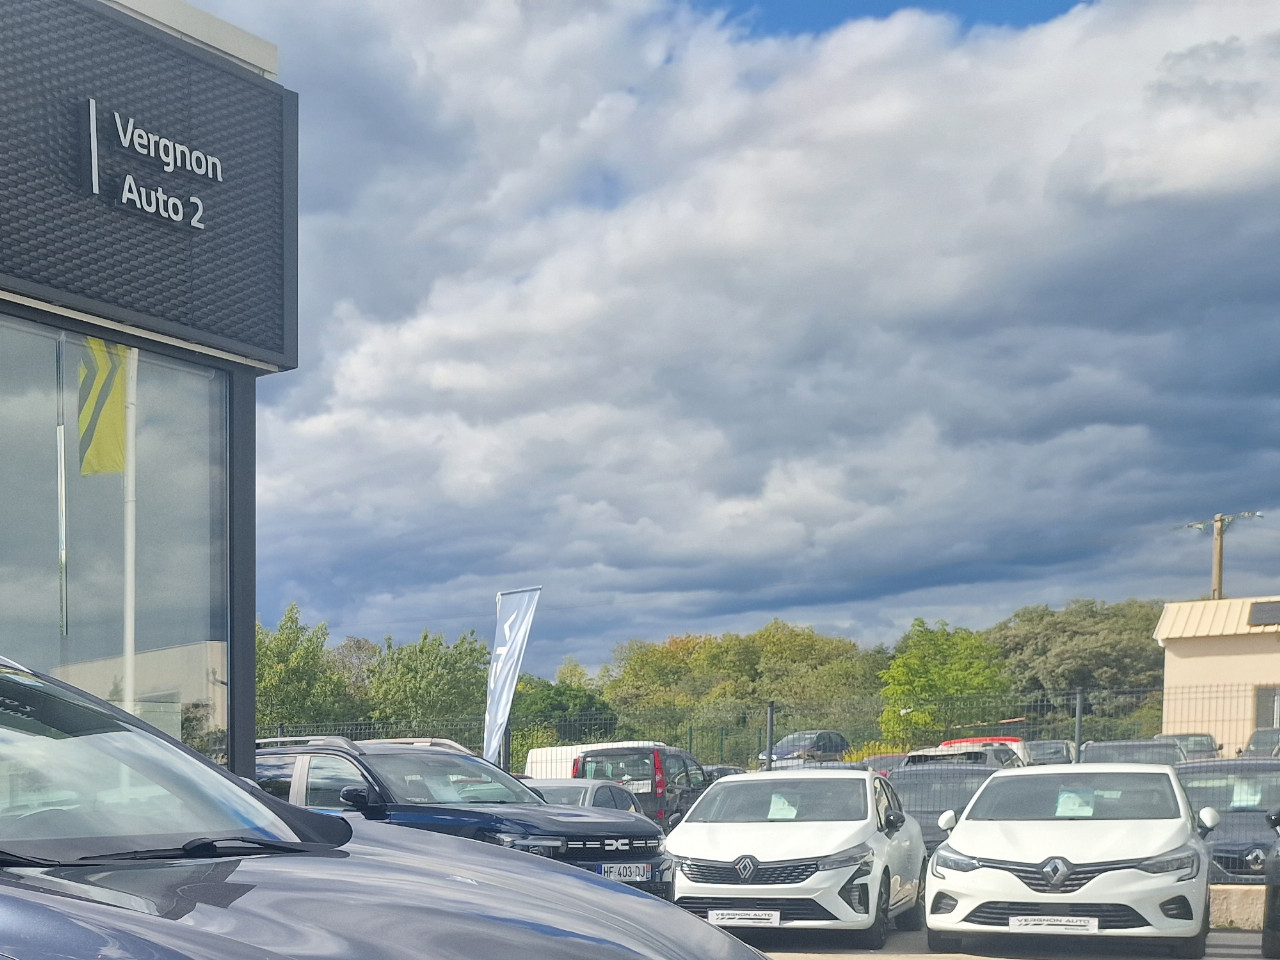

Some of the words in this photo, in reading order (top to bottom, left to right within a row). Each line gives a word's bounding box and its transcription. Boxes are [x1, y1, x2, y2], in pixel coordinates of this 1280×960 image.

[113, 111, 223, 181] Vergnon
[121, 174, 184, 222] Auto
[189, 196, 205, 230] 2
[603, 865, 646, 878] HF-403-DJ
